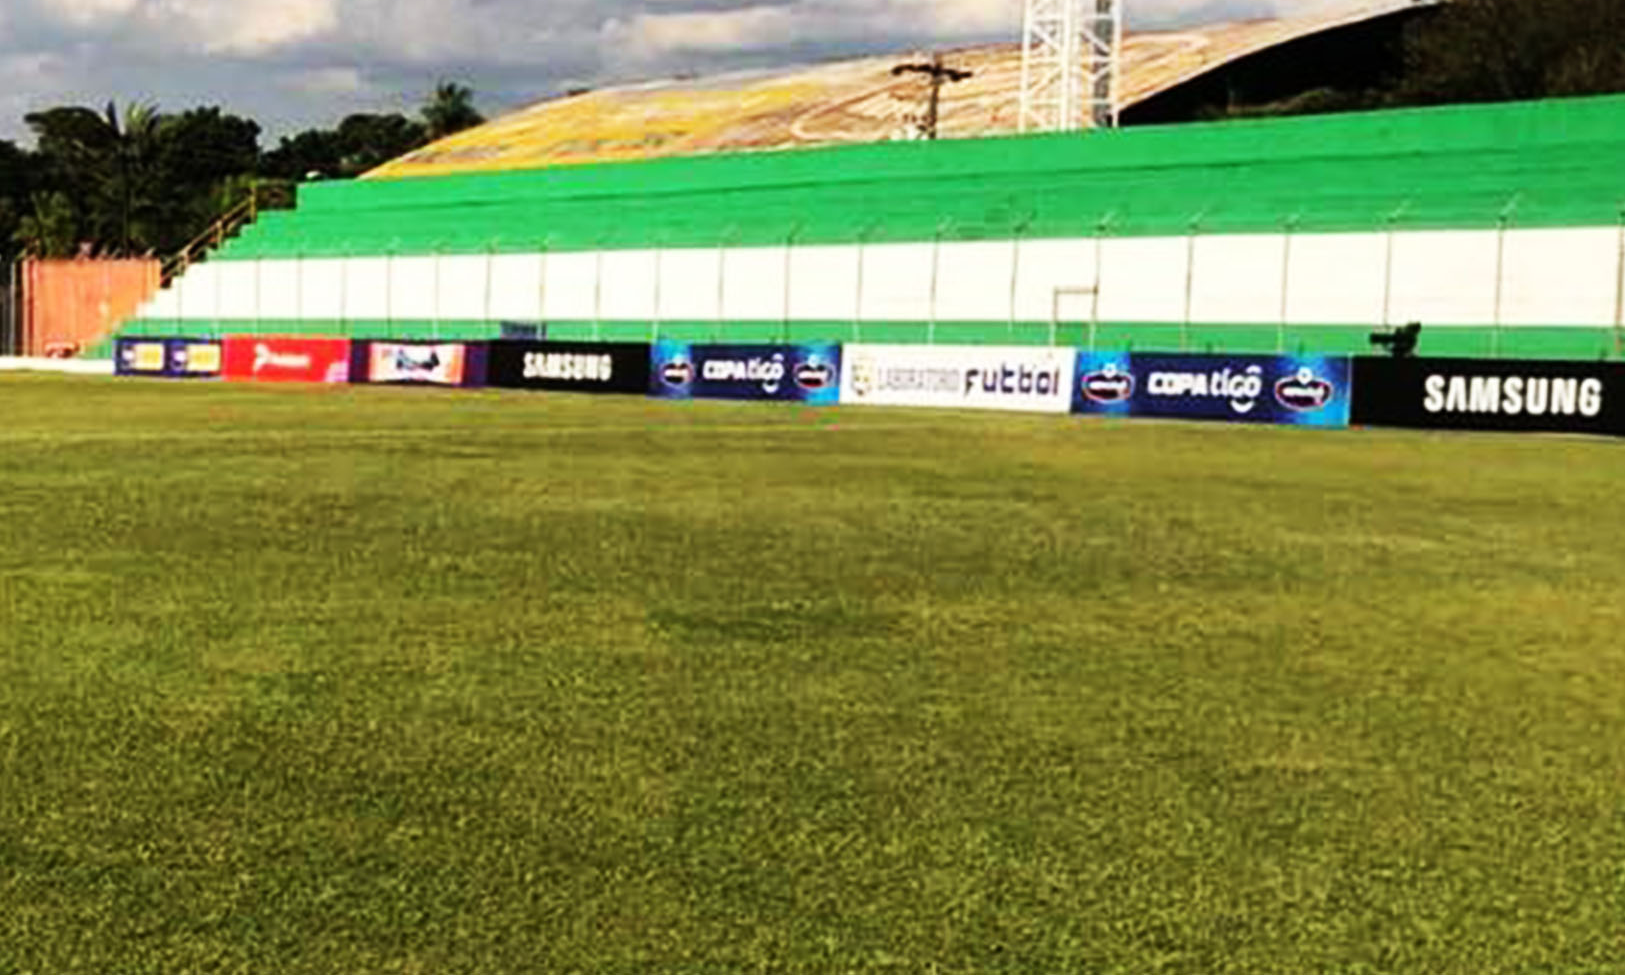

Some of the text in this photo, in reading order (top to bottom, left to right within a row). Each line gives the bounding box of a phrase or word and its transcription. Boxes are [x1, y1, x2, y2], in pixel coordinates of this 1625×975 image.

[523, 351, 612, 381] SAMSUNG
[702, 359, 747, 380] COPA
[1147, 371, 1208, 396] COPA
[1423, 374, 1603, 417] SAMSUNG
